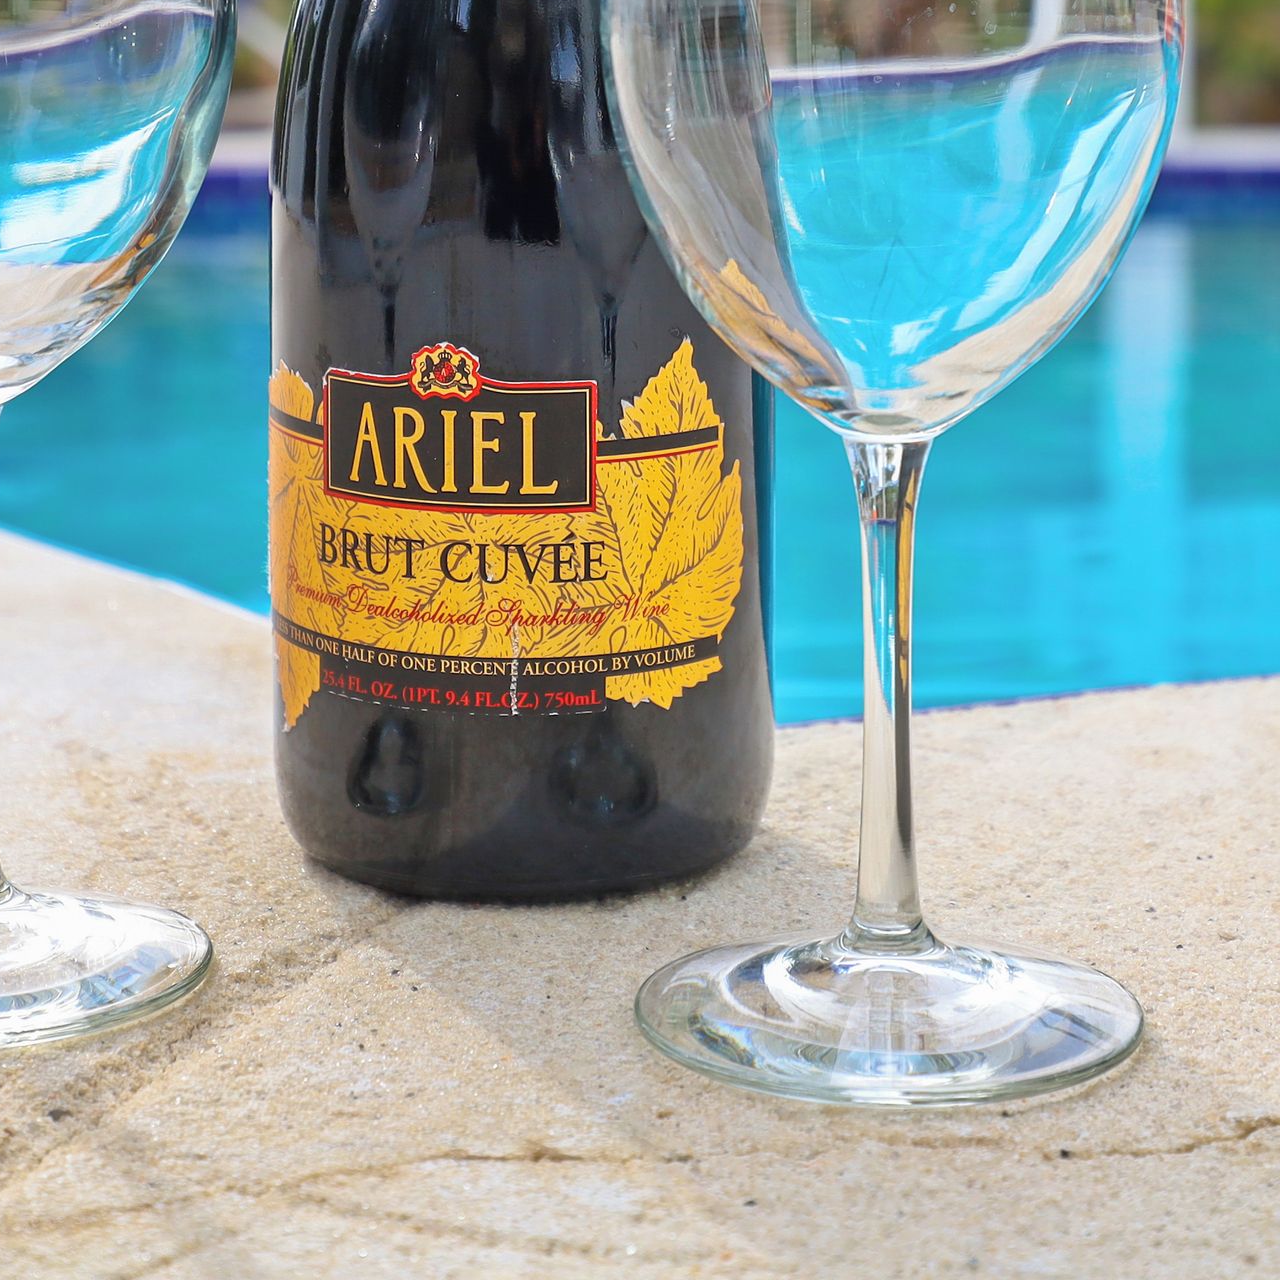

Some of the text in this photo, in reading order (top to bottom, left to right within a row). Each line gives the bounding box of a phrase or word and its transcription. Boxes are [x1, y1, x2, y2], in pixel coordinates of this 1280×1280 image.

[349, 401, 559, 495] ARIEL
[320, 522, 609, 585] BRUT CUVÉE
[287, 565, 670, 637] Premium Dealcoholized Sparkling Wine
[290, 624, 314, 648] THAN
[315, 636, 340, 656] ONE
[341, 644, 376, 664] HALF
[377, 652, 399, 668] OF
[401, 655, 437, 673] ONE
[440, 659, 519, 676] PERCENT
[522, 659, 608, 676] ALCOHOL
[611, 655, 632, 671] BY
[633, 644, 696, 668] VOLUME
[322, 668, 345, 689] 25.4
[347, 675, 368, 694] FL.
[371, 680, 399, 700] OZ.
[445, 690, 471, 707] 9.4
[544, 689, 602, 708] 750mL
